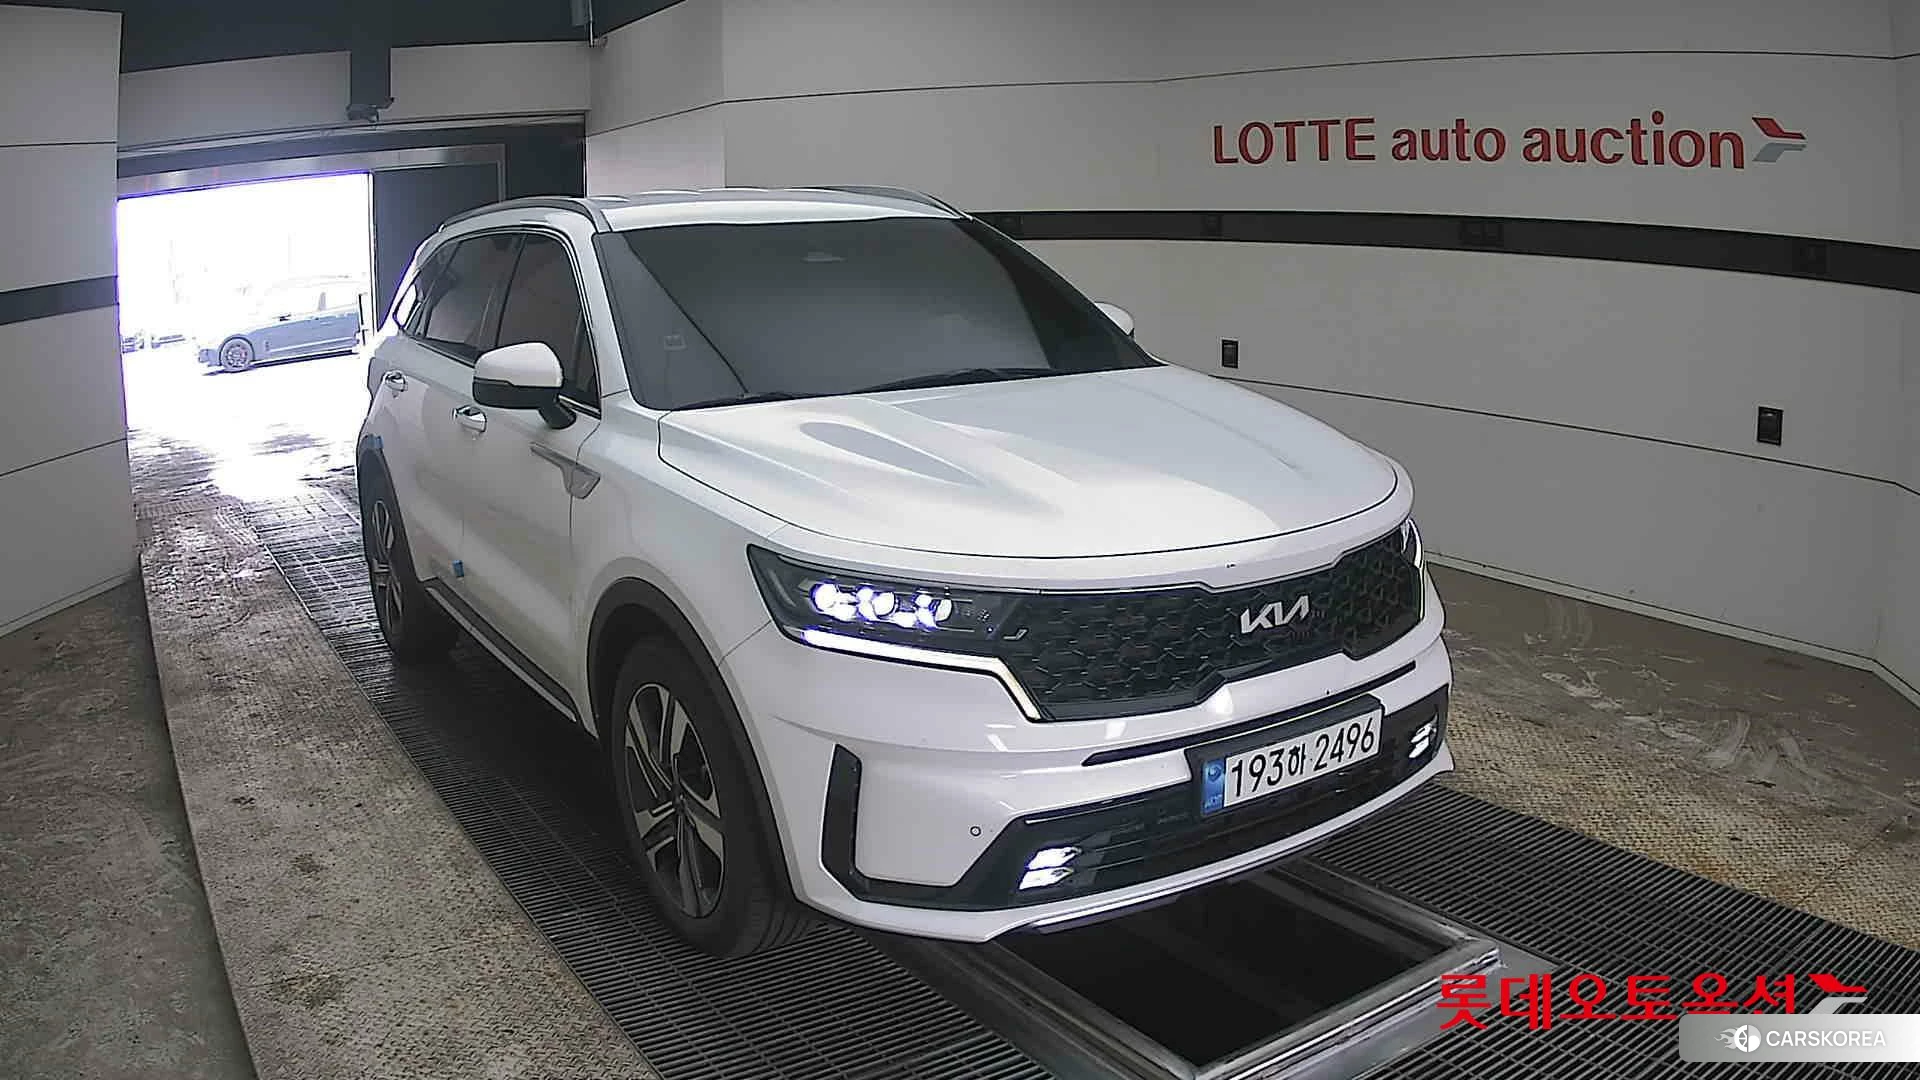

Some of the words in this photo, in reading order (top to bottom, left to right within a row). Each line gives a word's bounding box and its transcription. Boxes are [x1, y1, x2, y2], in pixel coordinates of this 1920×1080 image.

[1213, 117, 1376, 165] LOTTE
[1391, 117, 1506, 163] auto
[1522, 110, 1745, 169] auction
[1240, 595, 1310, 634] KIA
[1231, 742, 1306, 797] 193하
[1313, 717, 1375, 772] 2496
